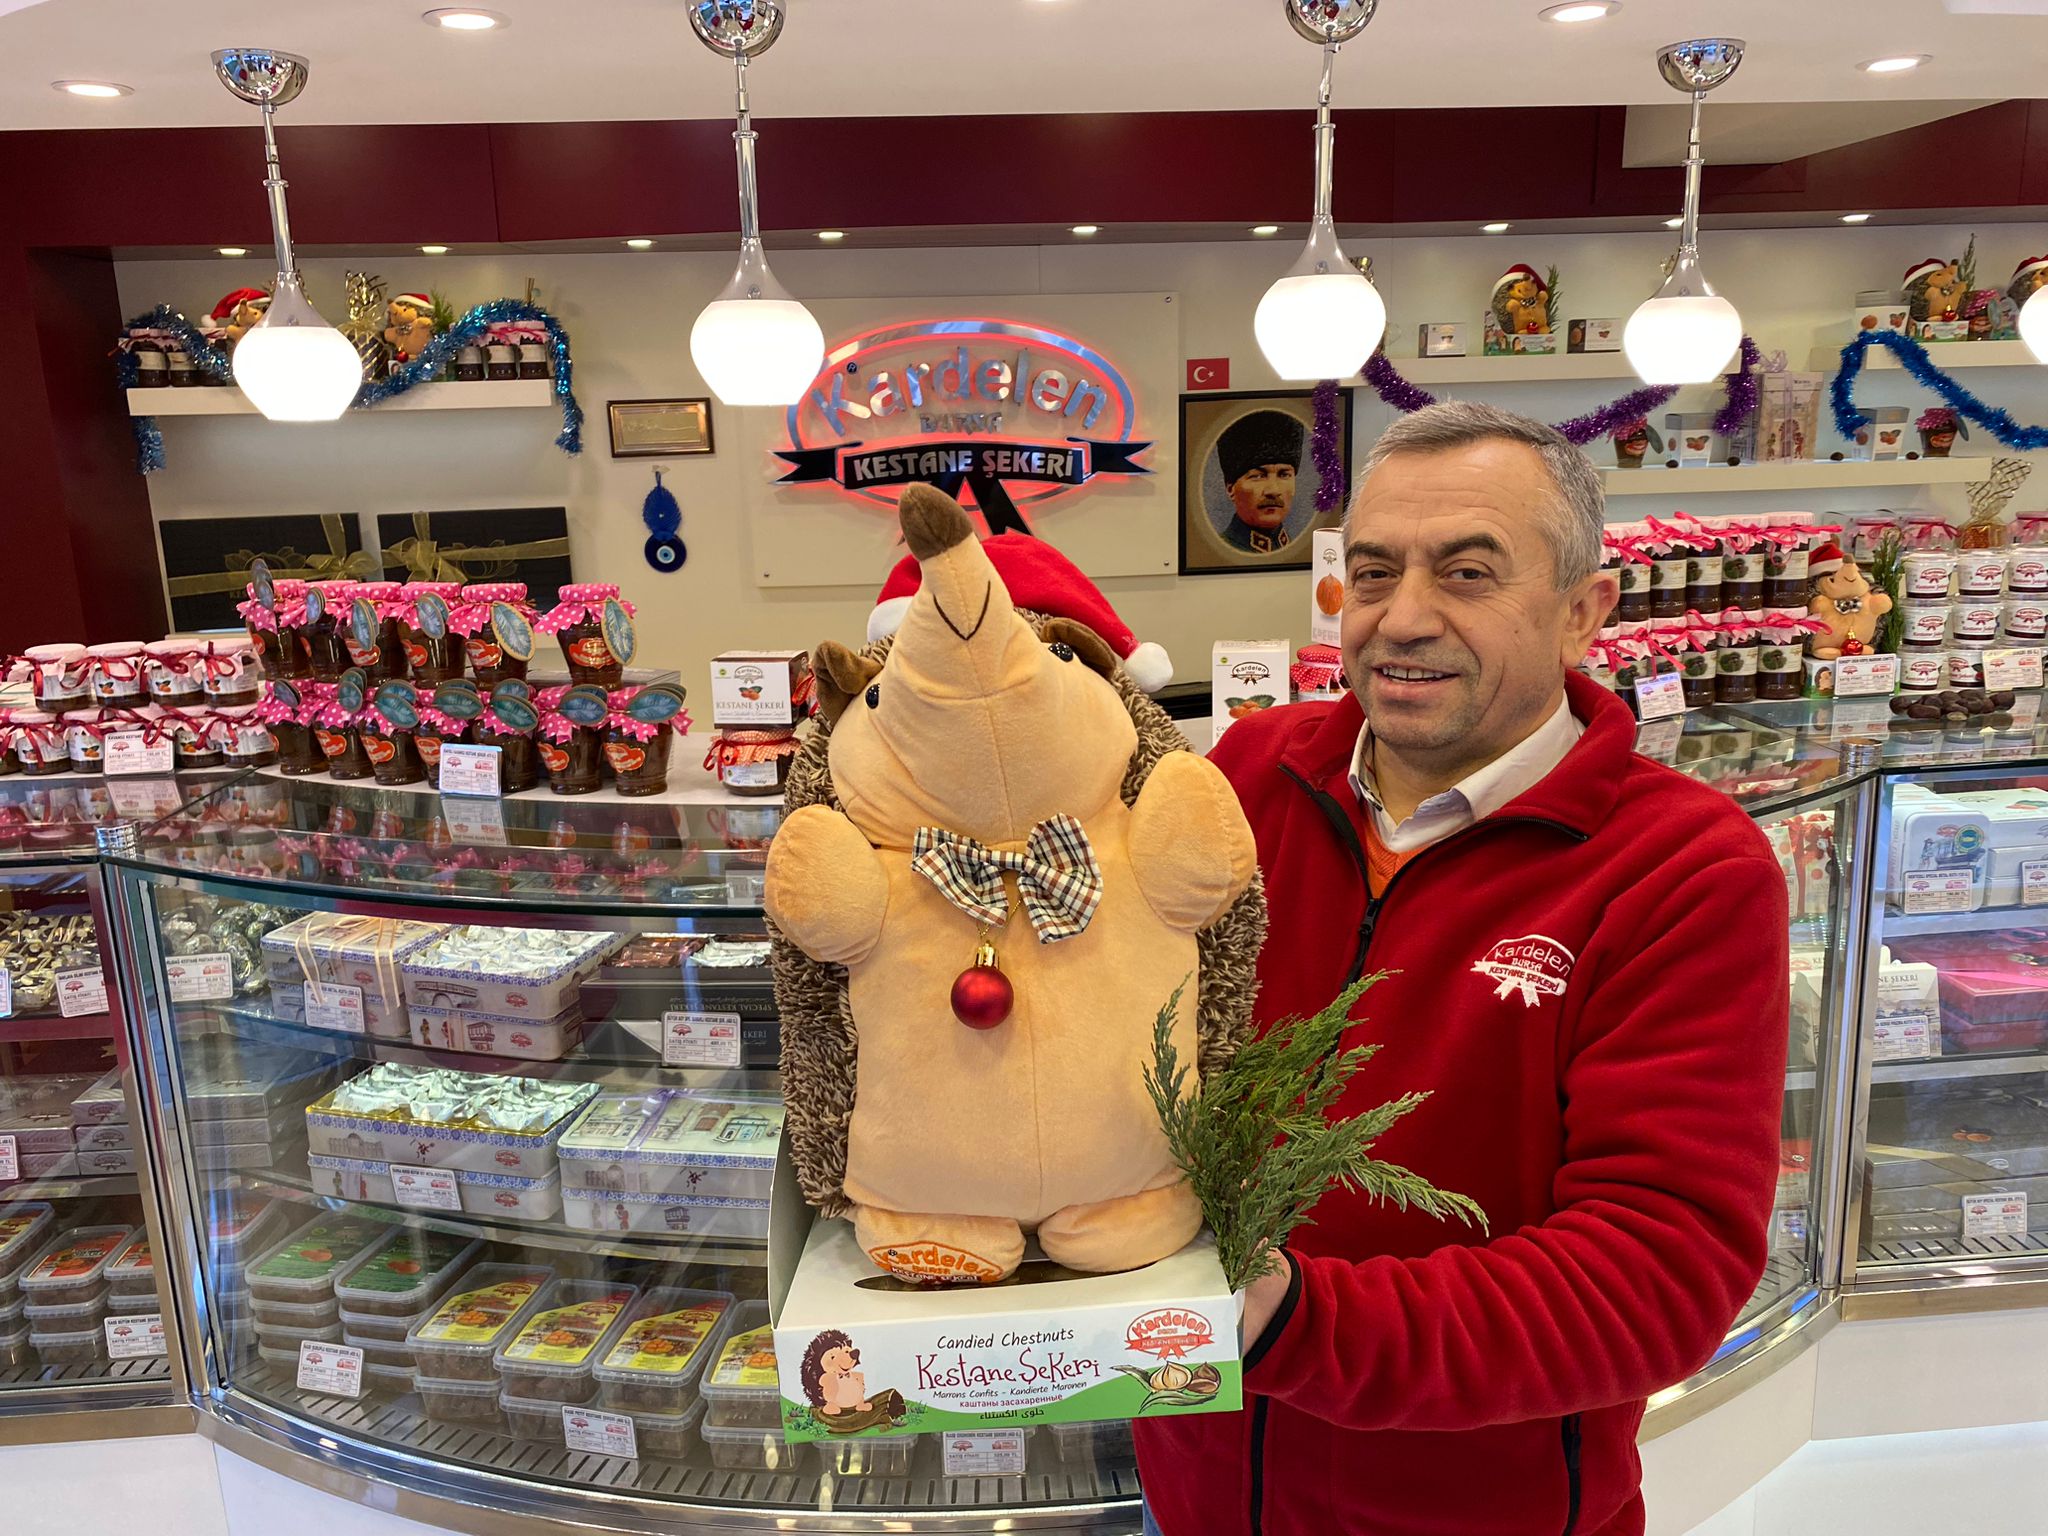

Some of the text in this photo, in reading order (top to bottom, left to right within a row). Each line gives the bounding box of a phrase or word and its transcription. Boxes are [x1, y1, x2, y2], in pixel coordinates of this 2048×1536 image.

[811, 346, 1108, 437] Kardelen
[853, 449, 1075, 481] KESTANE ŞEKERİ
[716, 700, 785, 711] KESTANE ŞEKERİ
[1494, 942, 1571, 977] Kardelen
[1512, 957, 1543, 972] BURSA
[1132, 1311, 1207, 1339] Kardelen
[937, 1328, 1074, 1349] Candied Chestnuts
[915, 1353, 1017, 1391] Kestane
[933, 1390, 967, 1399] Marrons
[969, 1388, 999, 1398] Confits
[1010, 1386, 1049, 1396] Kandierte
[1052, 1381, 1087, 1391] Maronen
[959, 1393, 1063, 1408] каштаны засахаренные
